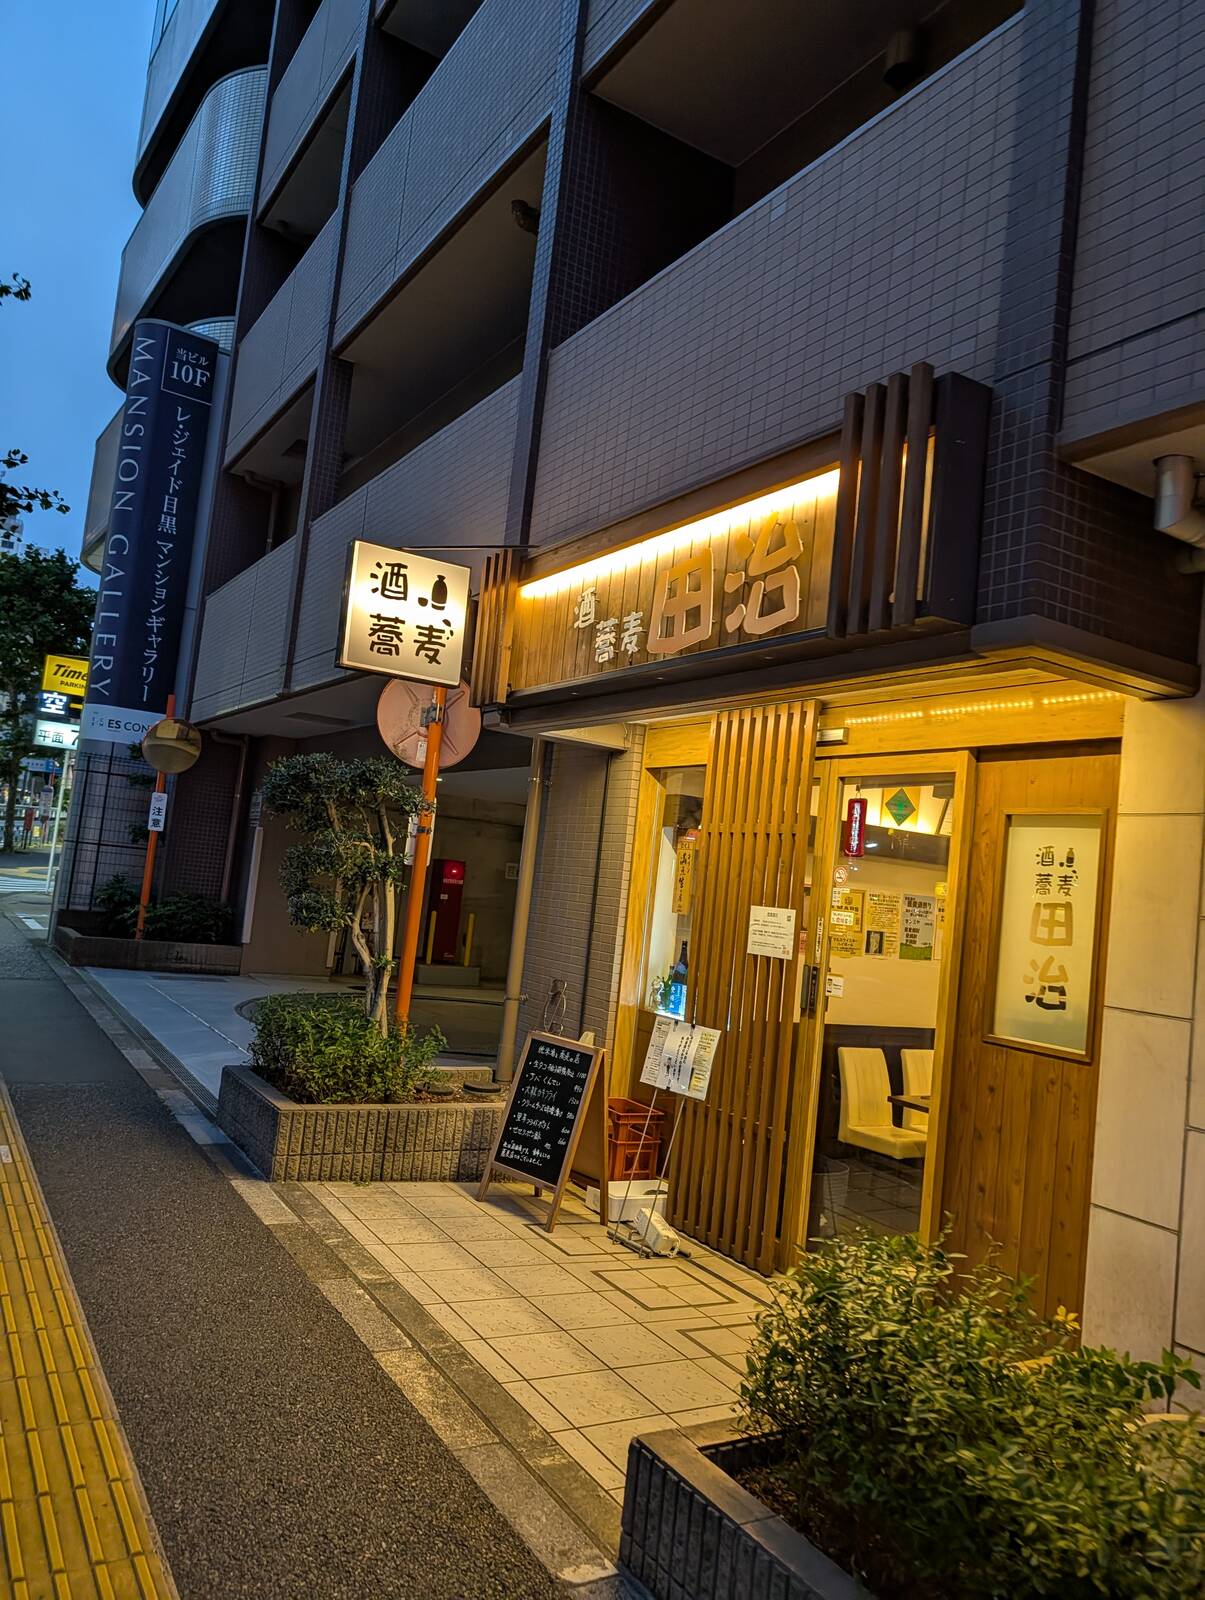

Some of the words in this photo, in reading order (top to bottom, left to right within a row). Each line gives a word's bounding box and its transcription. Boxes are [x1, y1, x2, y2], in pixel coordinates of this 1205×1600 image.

[171, 361, 211, 388] 10F
[176, 348, 209, 366] 当ビル
[114, 336, 156, 511] MANSION
[157, 406, 191, 535] レ・ジェイド目黒
[370, 561, 409, 602] 酒
[646, 511, 804, 654] 田治
[90, 533, 129, 697] GALLERY
[142, 539, 174, 702] マンションギャラリー
[573, 586, 600, 629] 酒
[368, 613, 449, 666] 蕎麦
[594, 611, 647, 664] 蕎麦
[40, 692, 67, 715] 空
[107, 719, 122, 730] ES
[38, 728, 64, 745] 平面
[152, 806, 163, 828] 注意
[1036, 845, 1055, 867] 酒
[1035, 873, 1074, 897] 蕎麦
[1022, 901, 1074, 1011] 田治
